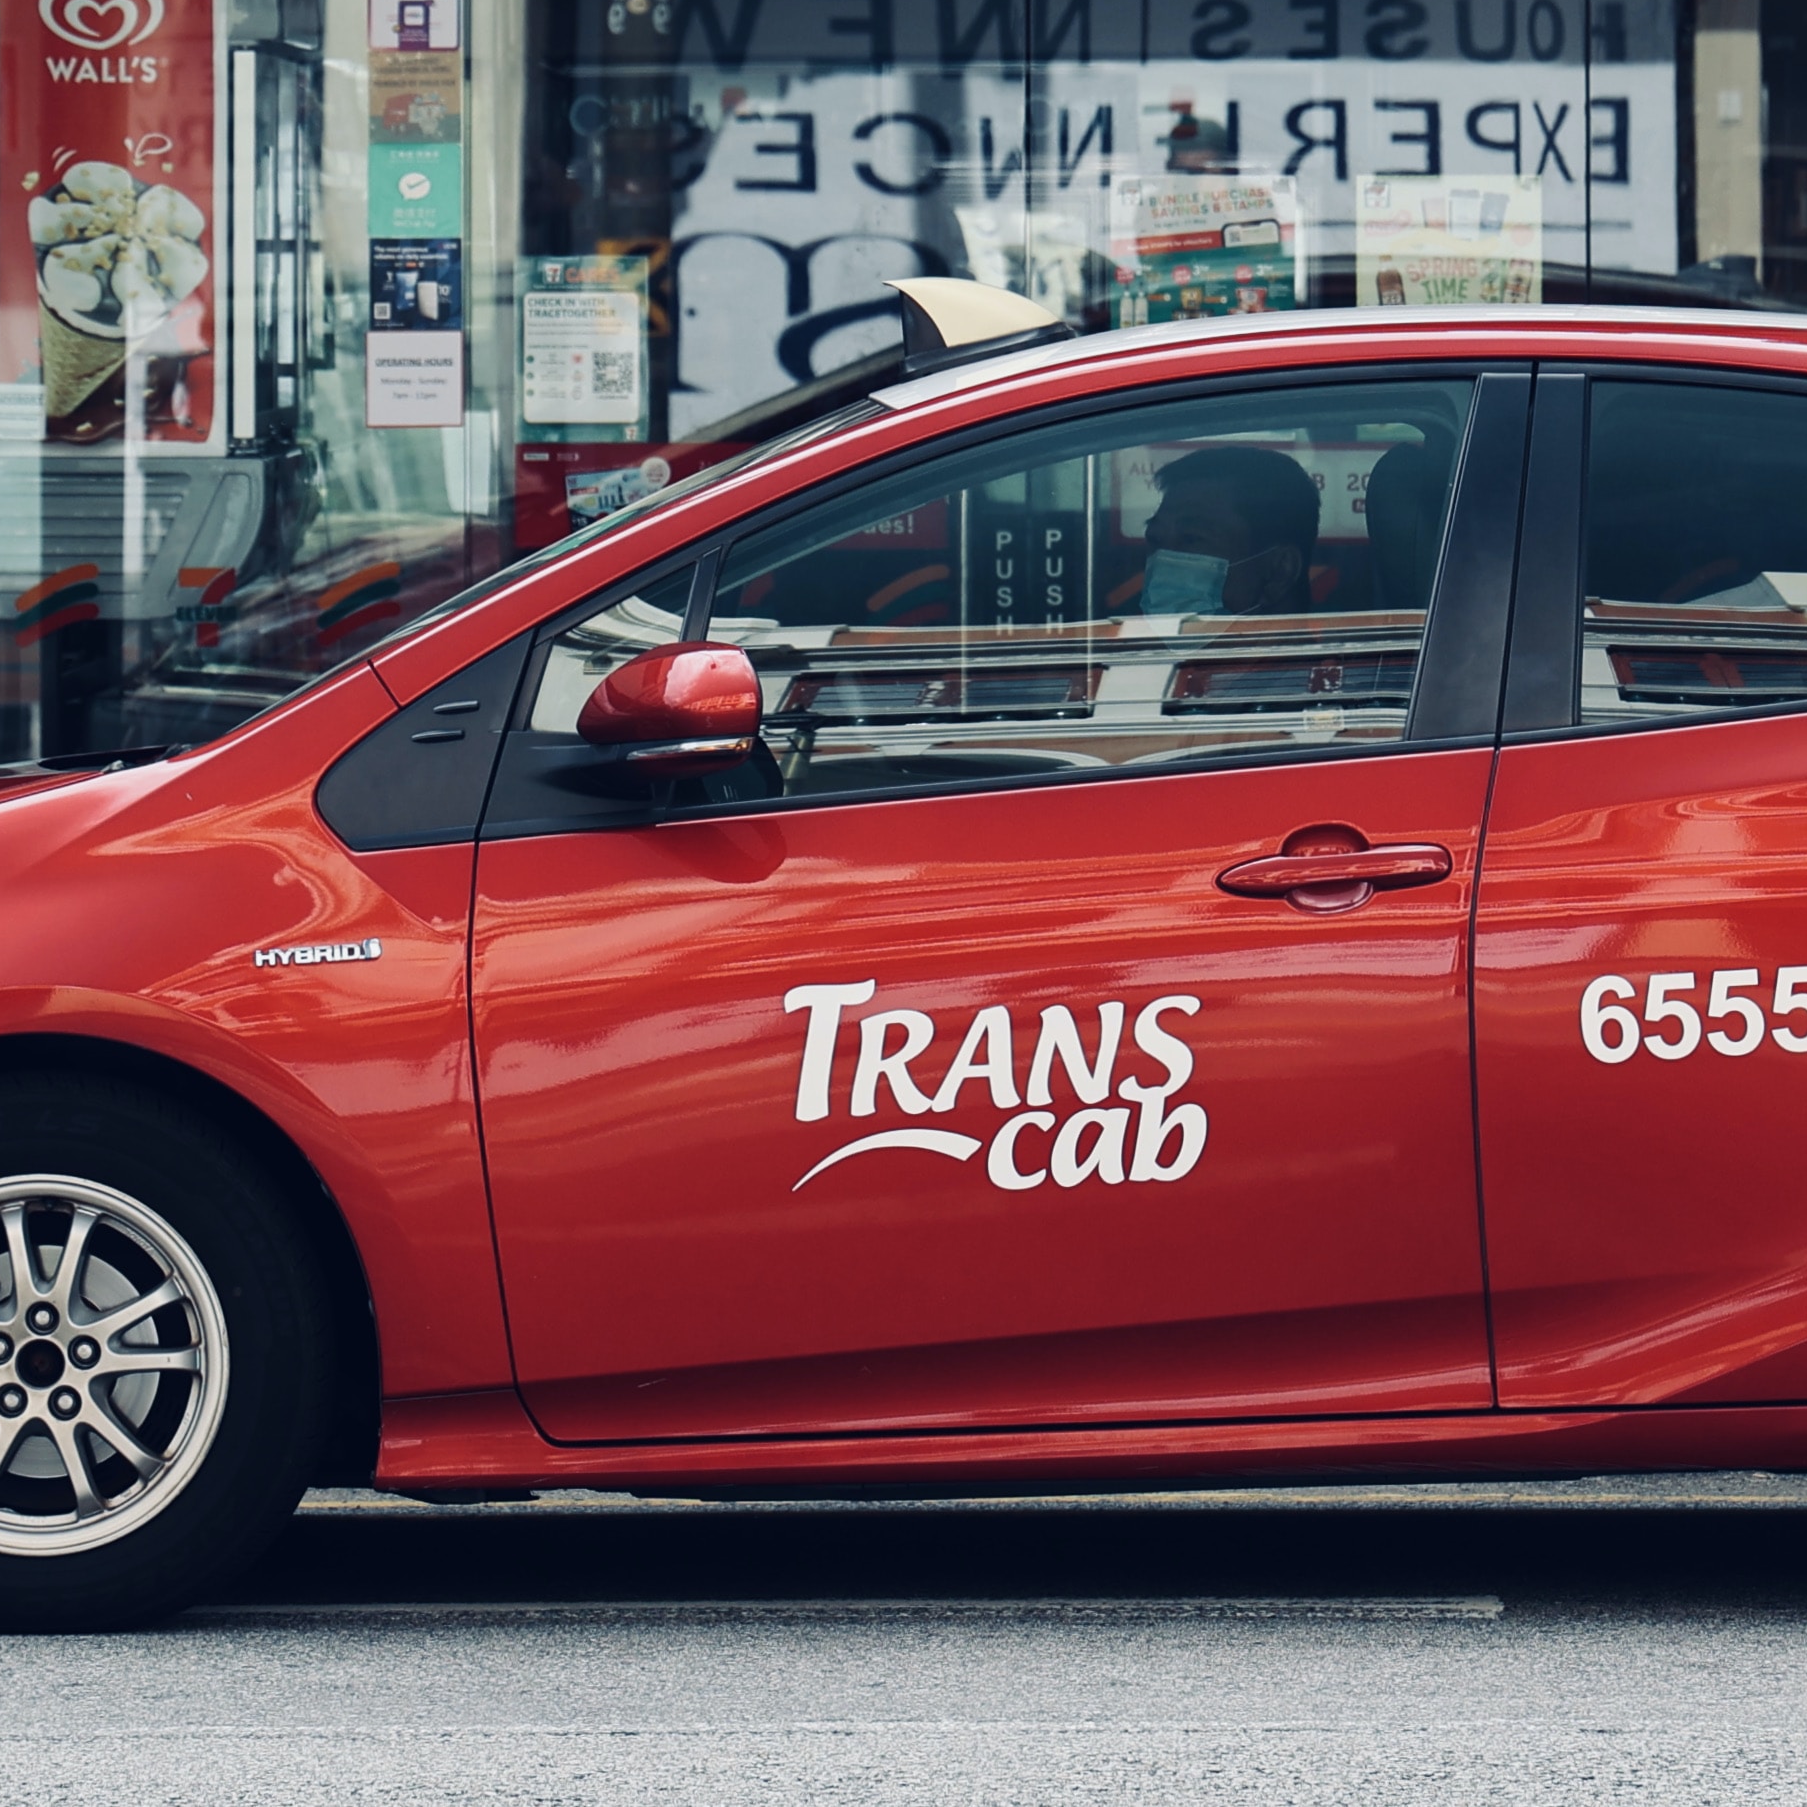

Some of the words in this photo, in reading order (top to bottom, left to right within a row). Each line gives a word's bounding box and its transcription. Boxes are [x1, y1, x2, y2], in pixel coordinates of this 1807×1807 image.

[46, 56, 158, 83] WALL'S
[1151, 205, 1209, 219] SAVINGS
[1225, 198, 1274, 212] STAMPS
[1406, 257, 1478, 282] SPRING
[1421, 278, 1469, 300] TIME
[528, 298, 561, 308] CHECK
[564, 298, 576, 308] IN
[528, 309, 616, 319] TRACETOGETHER
[375, 357, 422, 367] OPERATING
[996, 530, 1014, 636] PUSH
[1045, 529, 1064, 635] PUSH
[254, 942, 364, 967] HYBRID
[987, 1082, 1208, 1191] cab
